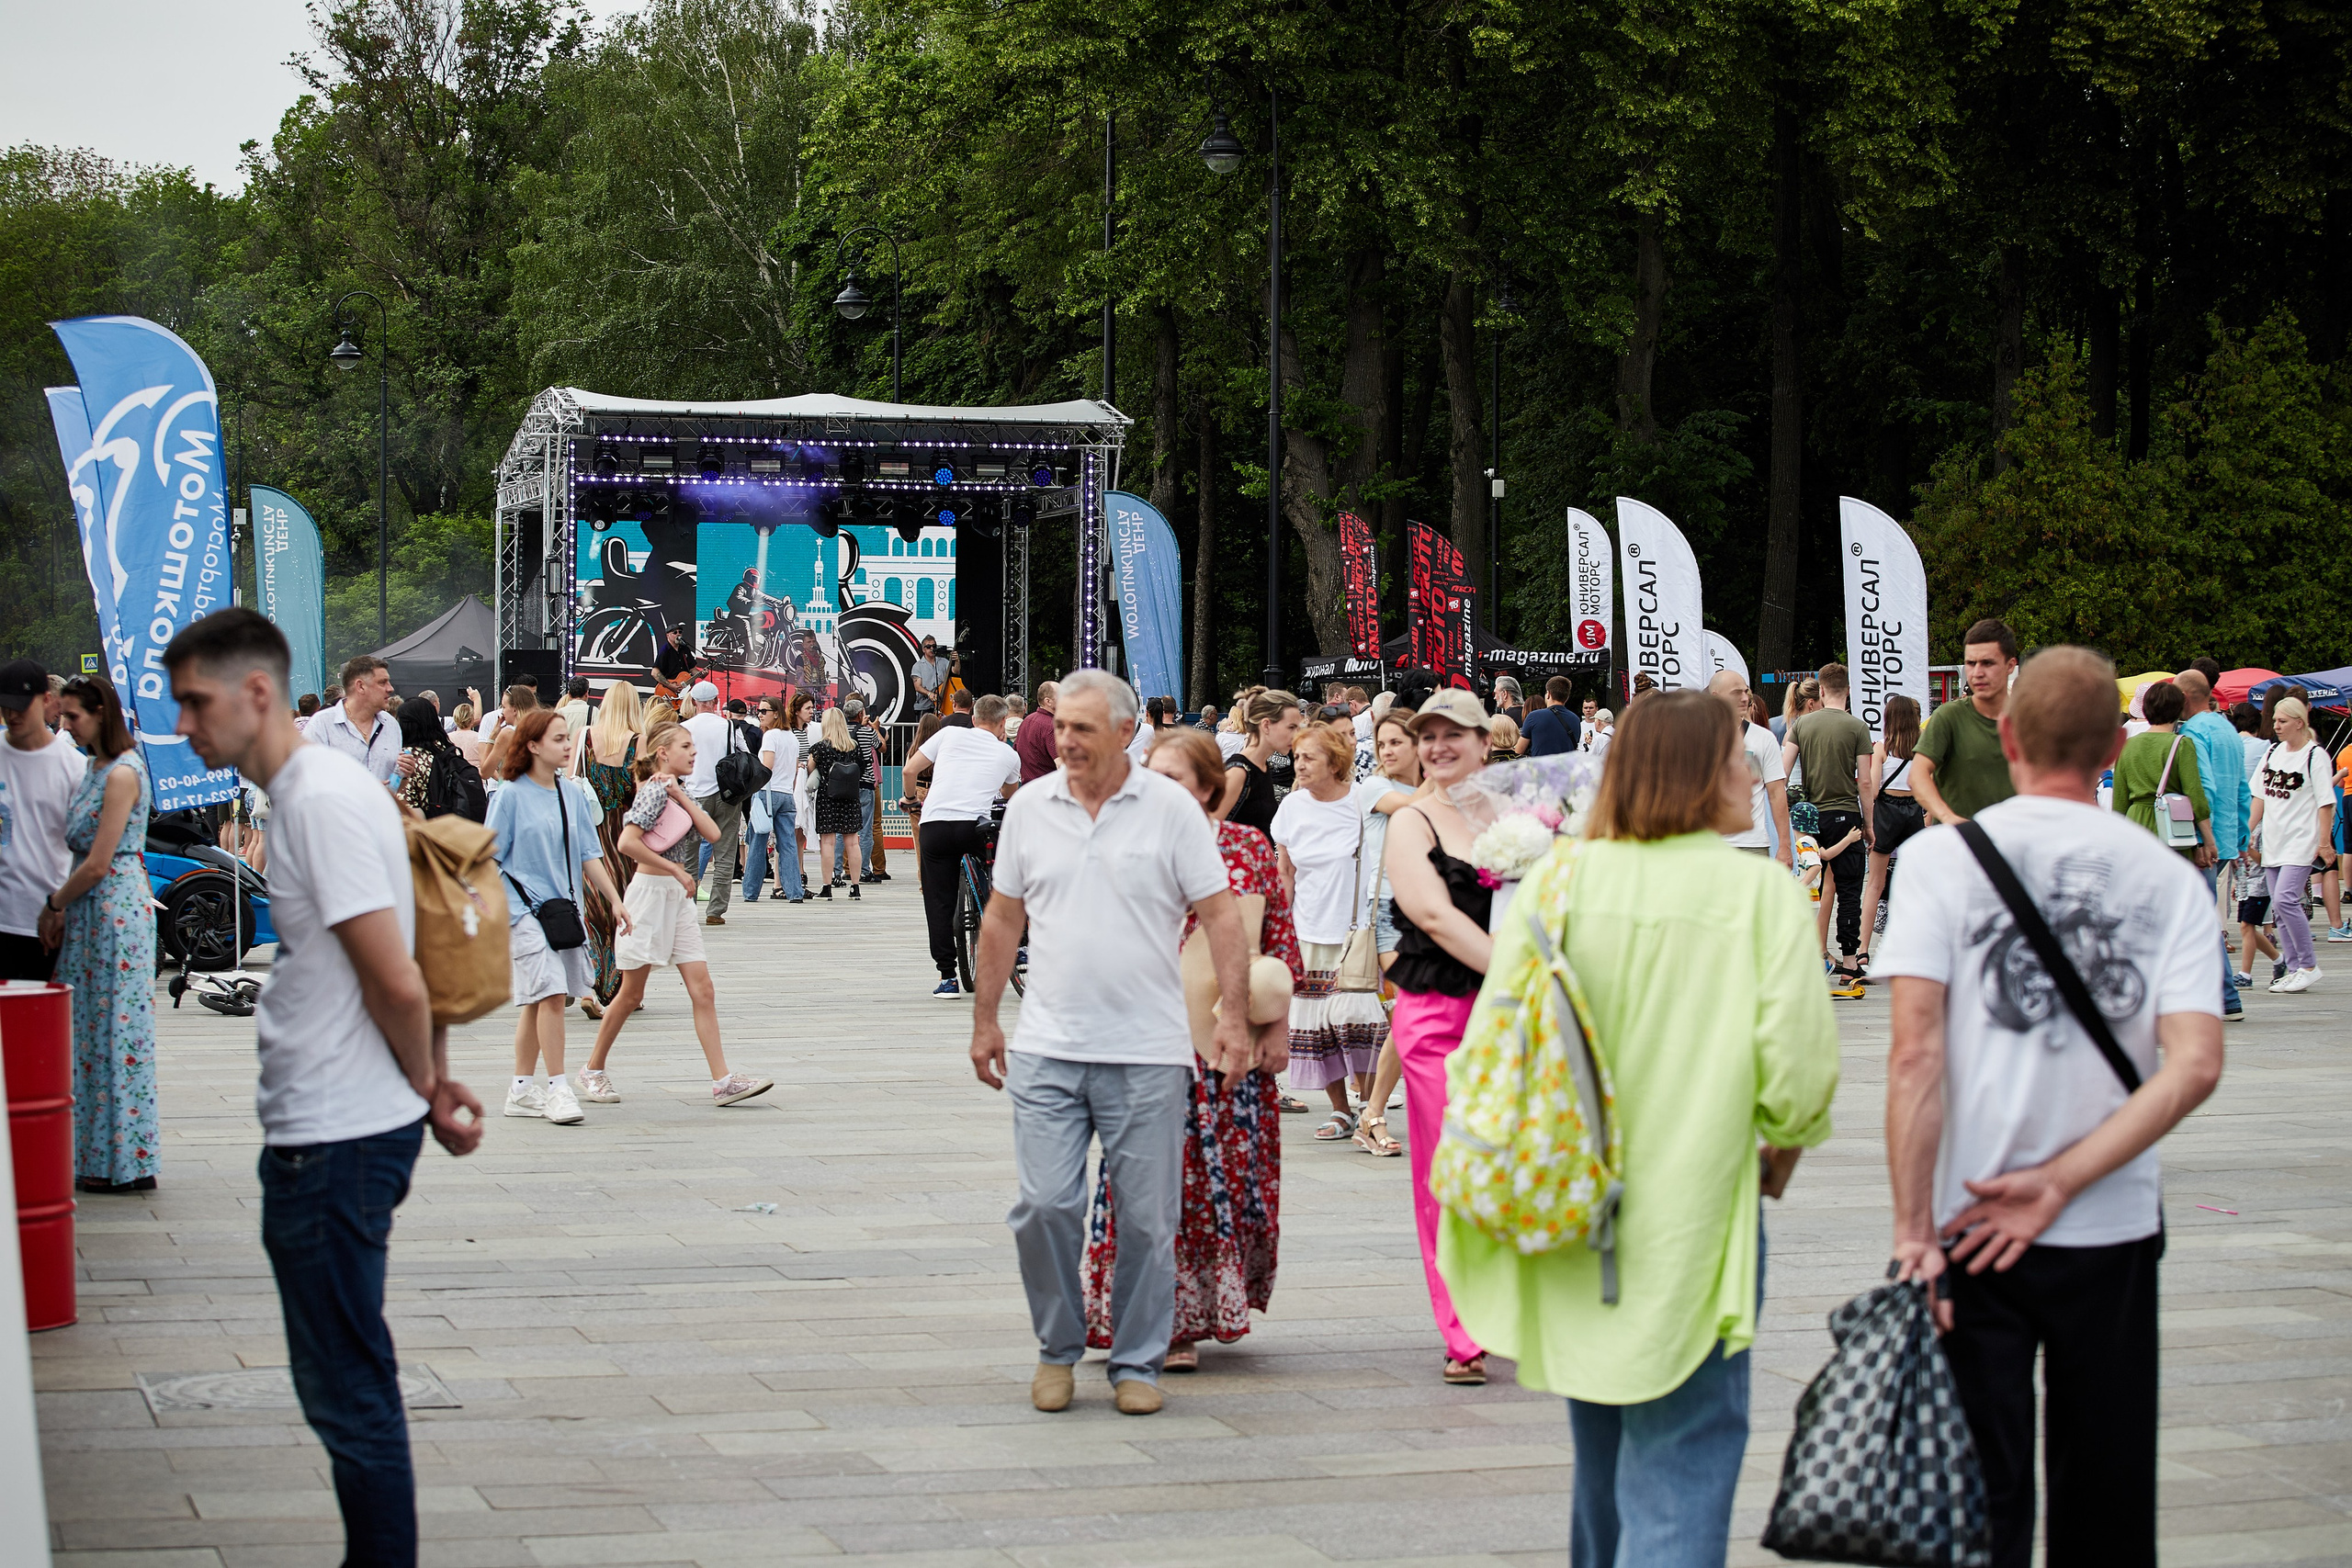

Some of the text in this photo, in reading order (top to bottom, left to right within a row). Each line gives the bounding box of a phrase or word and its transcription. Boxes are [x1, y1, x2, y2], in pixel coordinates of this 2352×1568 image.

[1579, 531, 1589, 615] ЮНИВЕРСАЛ
[1589, 560, 1600, 615] МОТОРС
[1464, 599, 1474, 677] magazine
[1477, 649, 1600, 666] -magazine.ru
[1638, 560, 1659, 689] ИВЕРСАЛ
[1661, 622, 1682, 693] ТОРС
[1860, 558, 1882, 732] ЮНИВЕРСАЛ
